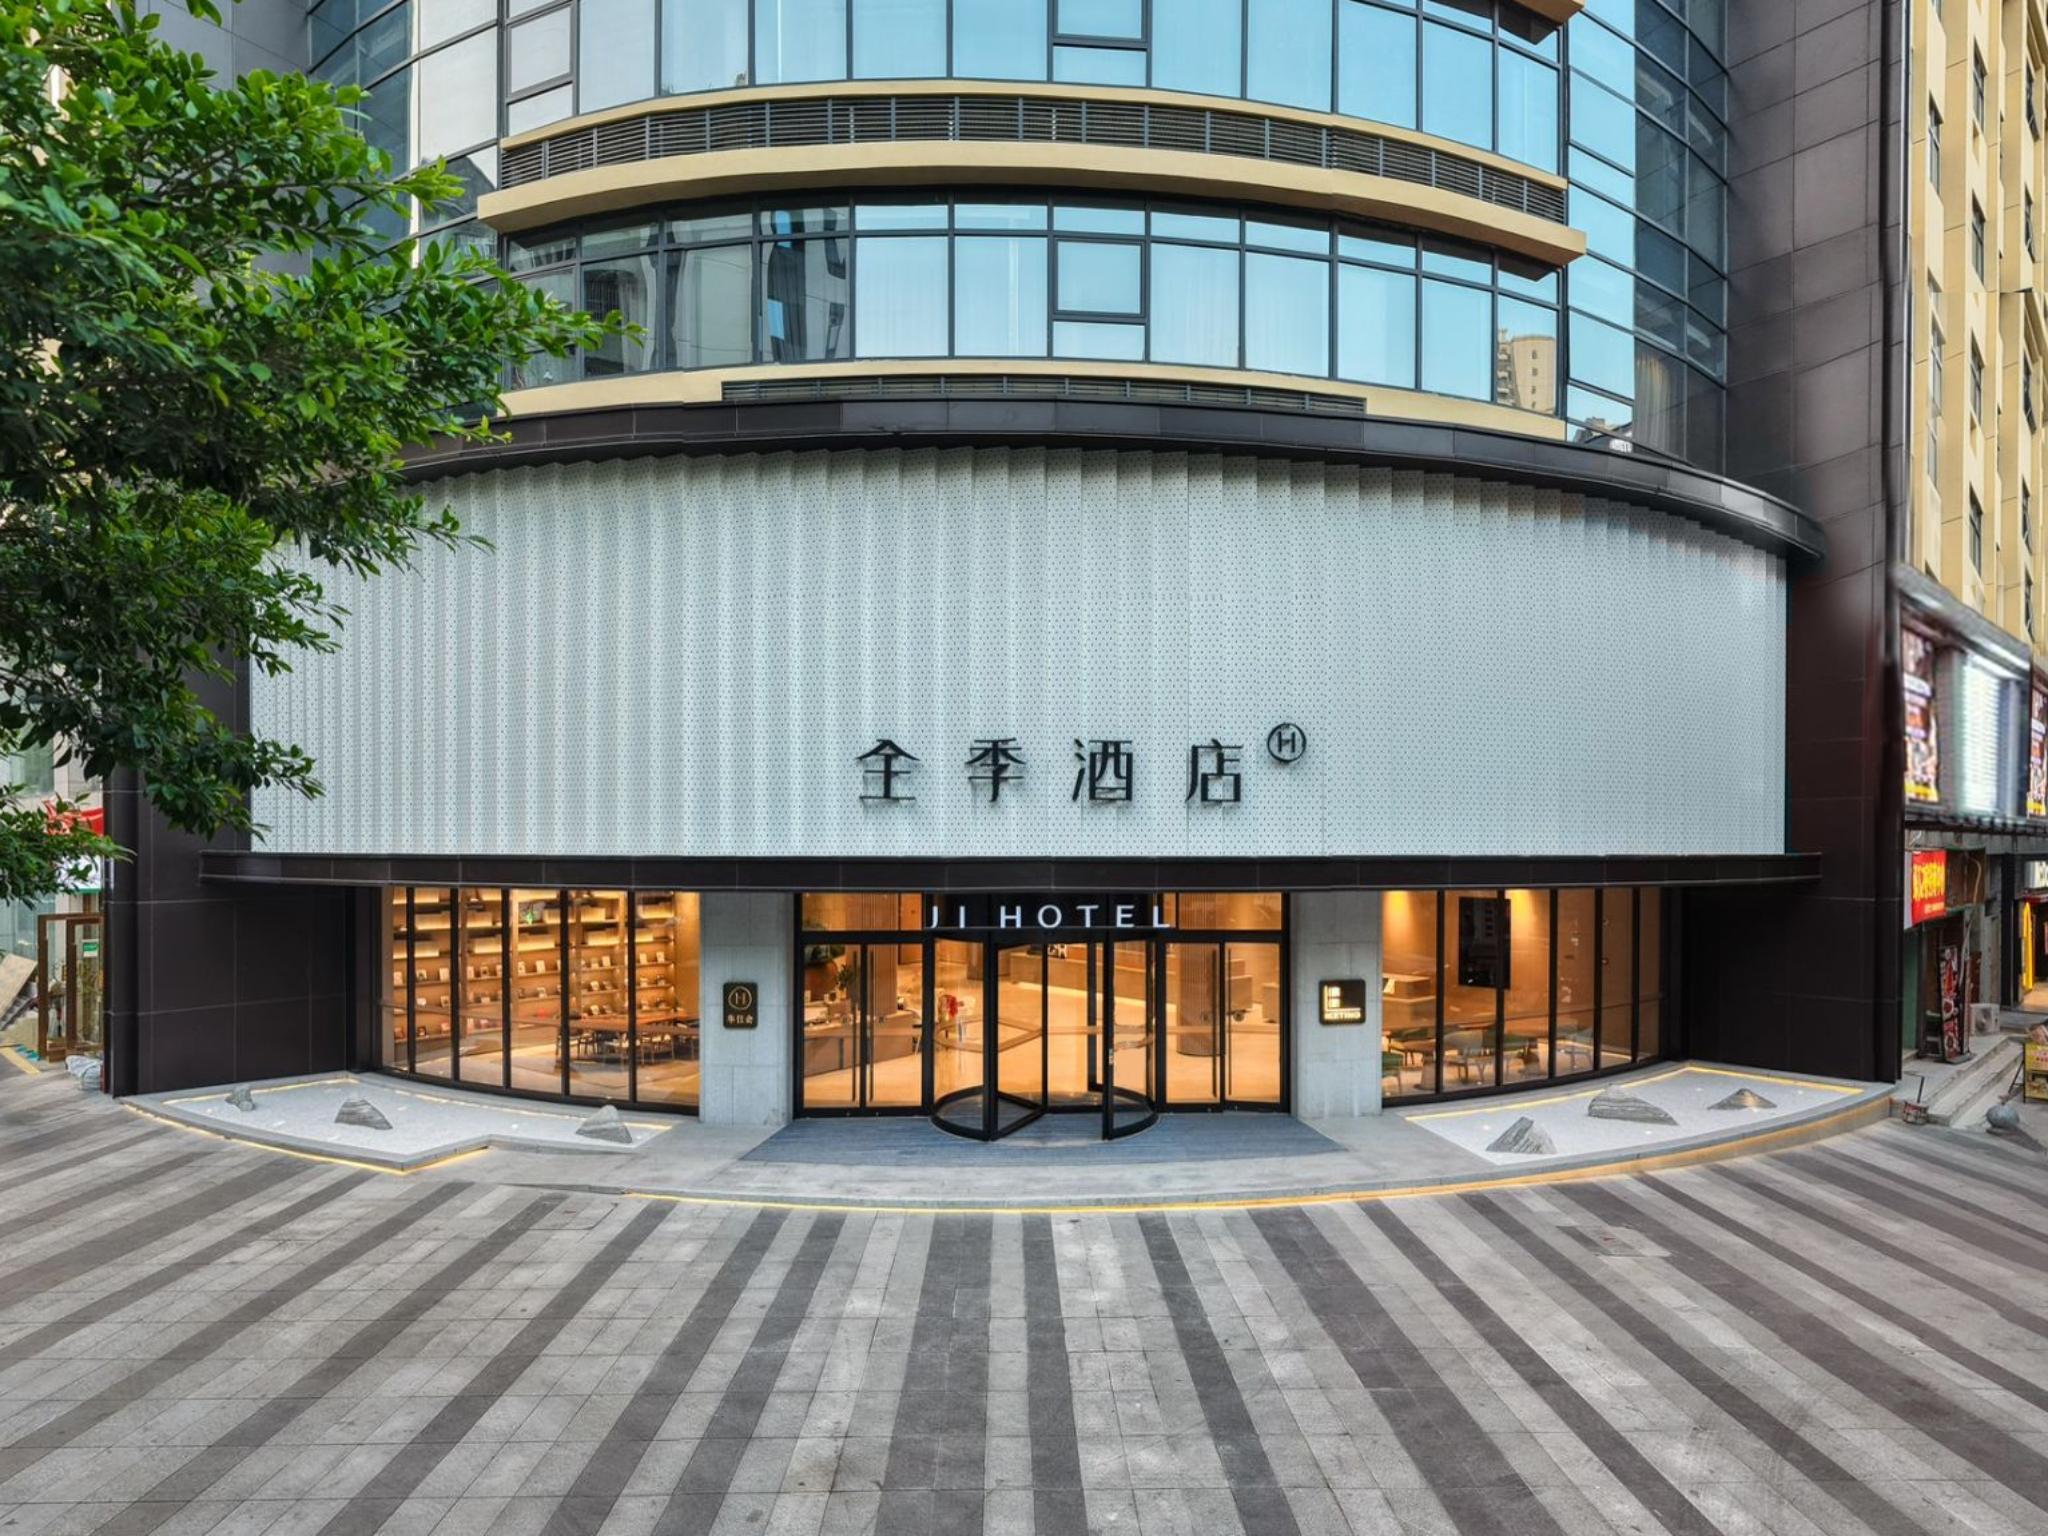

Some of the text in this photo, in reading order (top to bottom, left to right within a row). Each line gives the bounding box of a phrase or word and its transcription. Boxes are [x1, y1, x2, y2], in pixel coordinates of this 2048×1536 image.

[856, 738, 1244, 804] 全季酒店
[930, 905, 1170, 929] JI HOTEL
